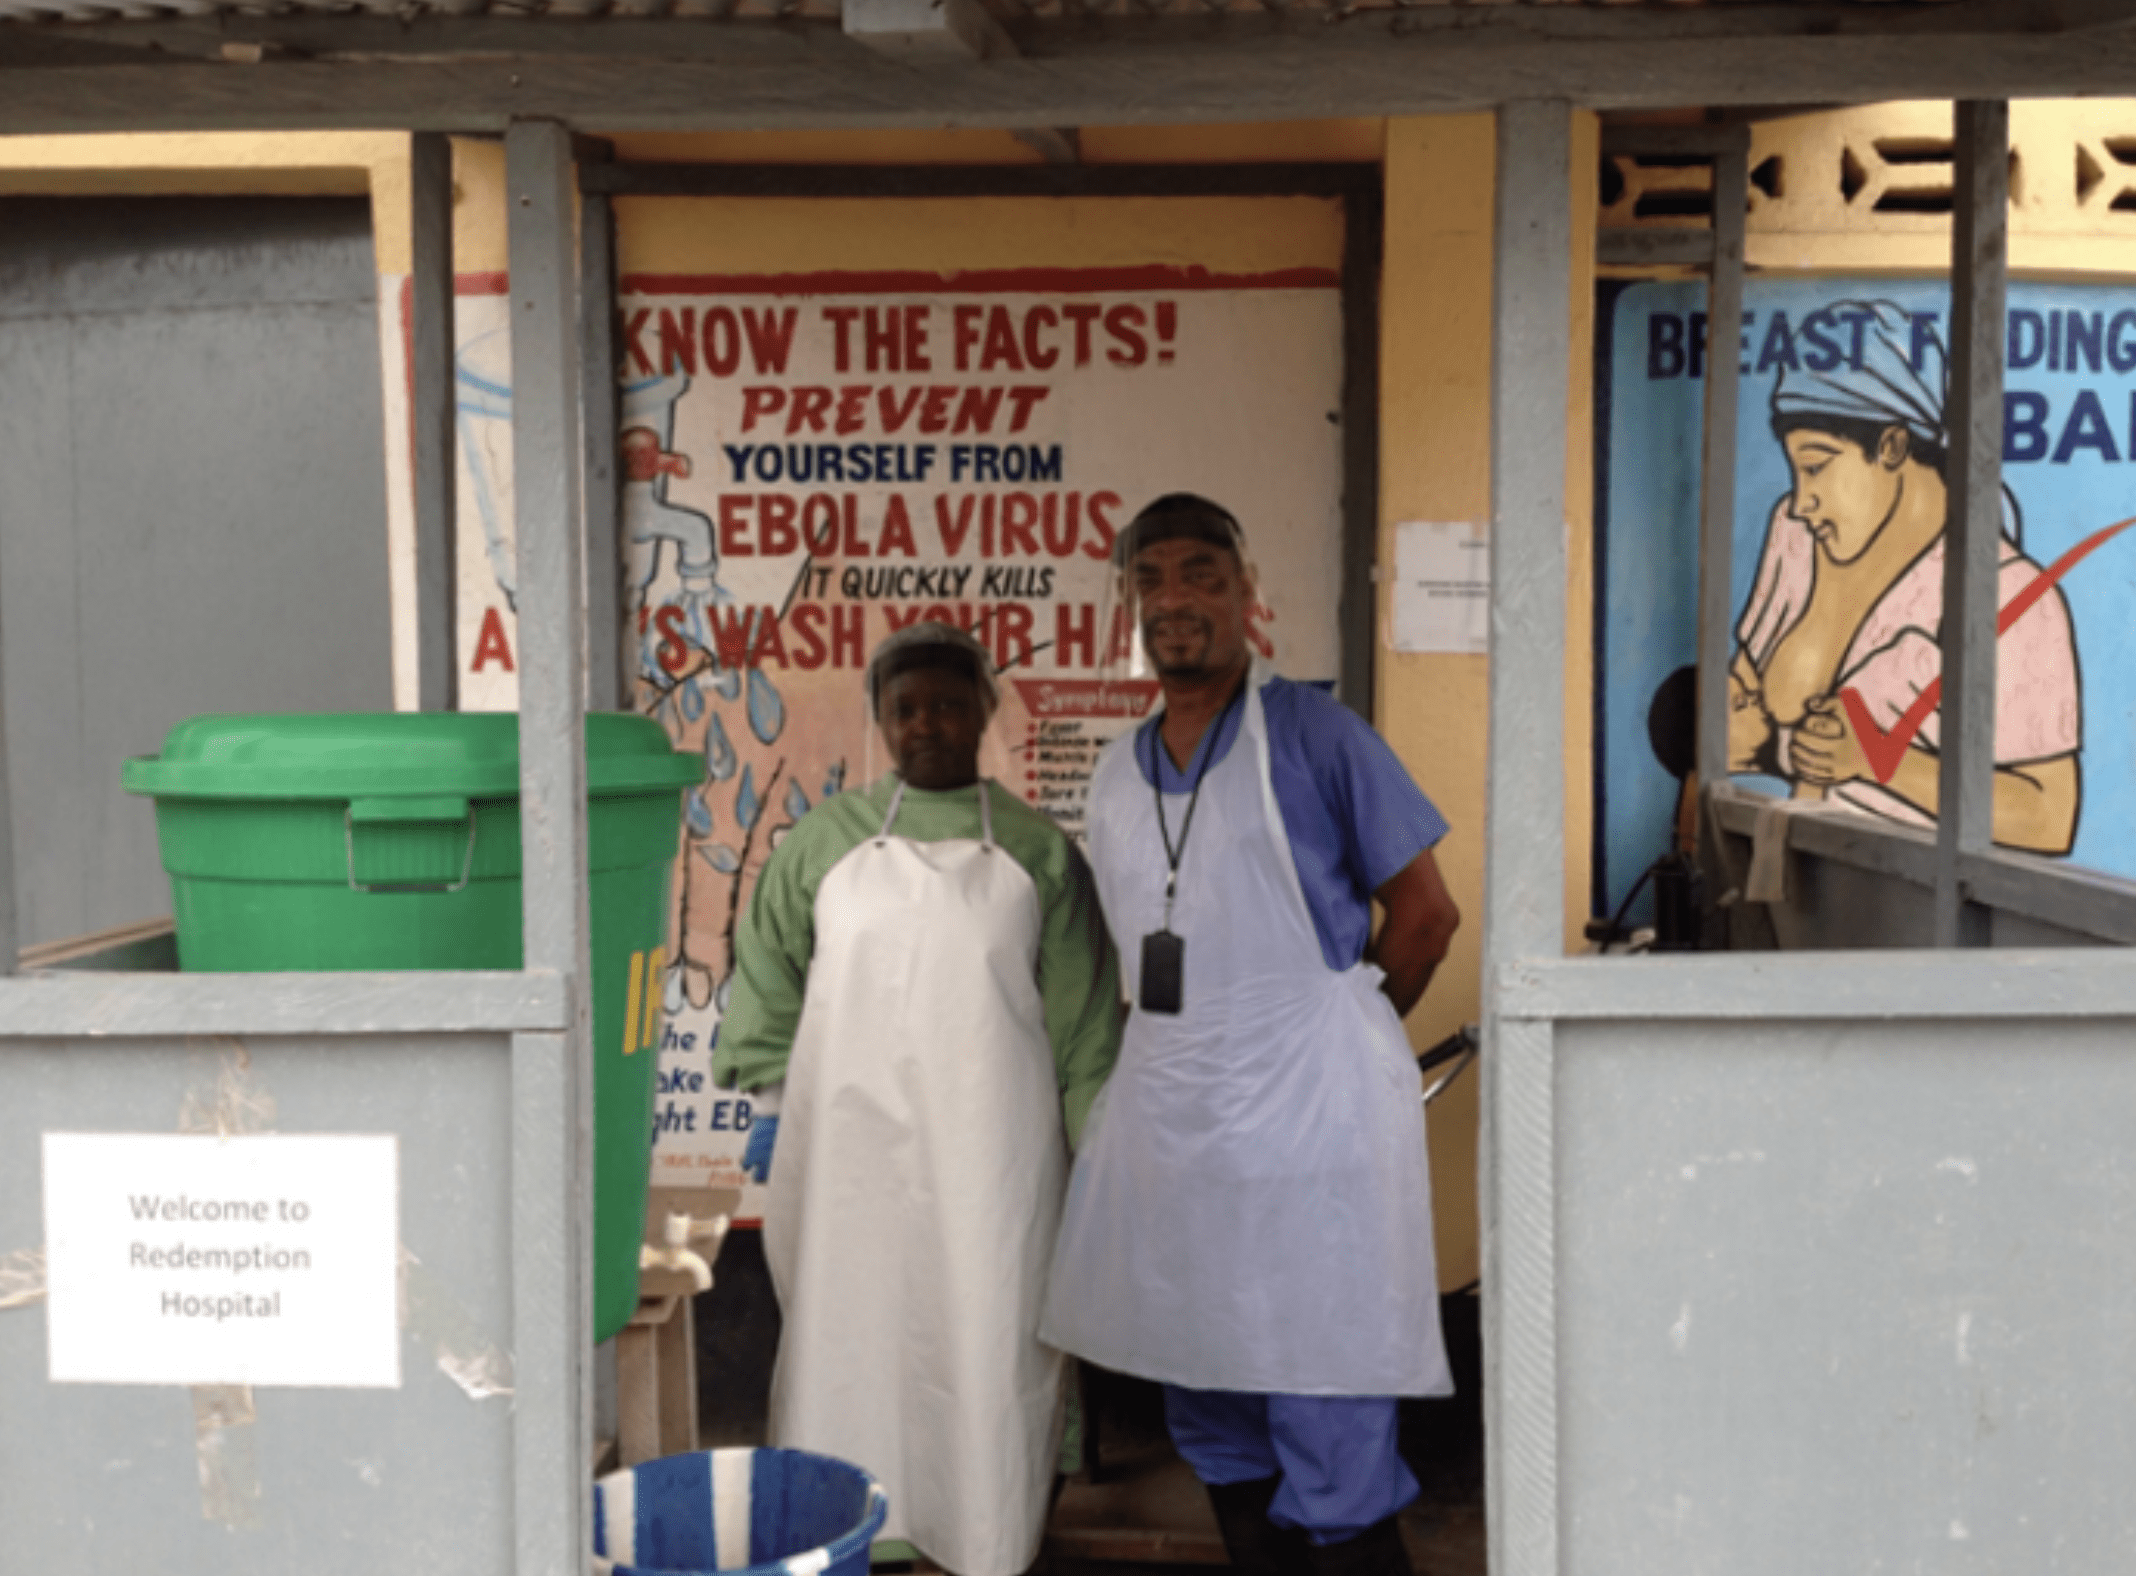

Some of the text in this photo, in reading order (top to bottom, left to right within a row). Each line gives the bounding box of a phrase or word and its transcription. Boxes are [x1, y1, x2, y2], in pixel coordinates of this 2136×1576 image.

[620, 301, 1176, 378] KNOW THE FACTS!
[1908, 308, 2136, 376] FDING
[740, 384, 1049, 436] PREVENT
[2001, 388, 2136, 464] BA
[723, 444, 1063, 483] YOURSELF FROM
[719, 491, 1123, 560] EBOLA VIRUS
[803, 567, 1056, 599] IT QUICKLY KILLS
[707, 602, 865, 669] WASH
[127, 1194, 312, 1223] Welcome to
[129, 1241, 312, 1275] Redemption
[160, 1290, 281, 1323] Hospital
